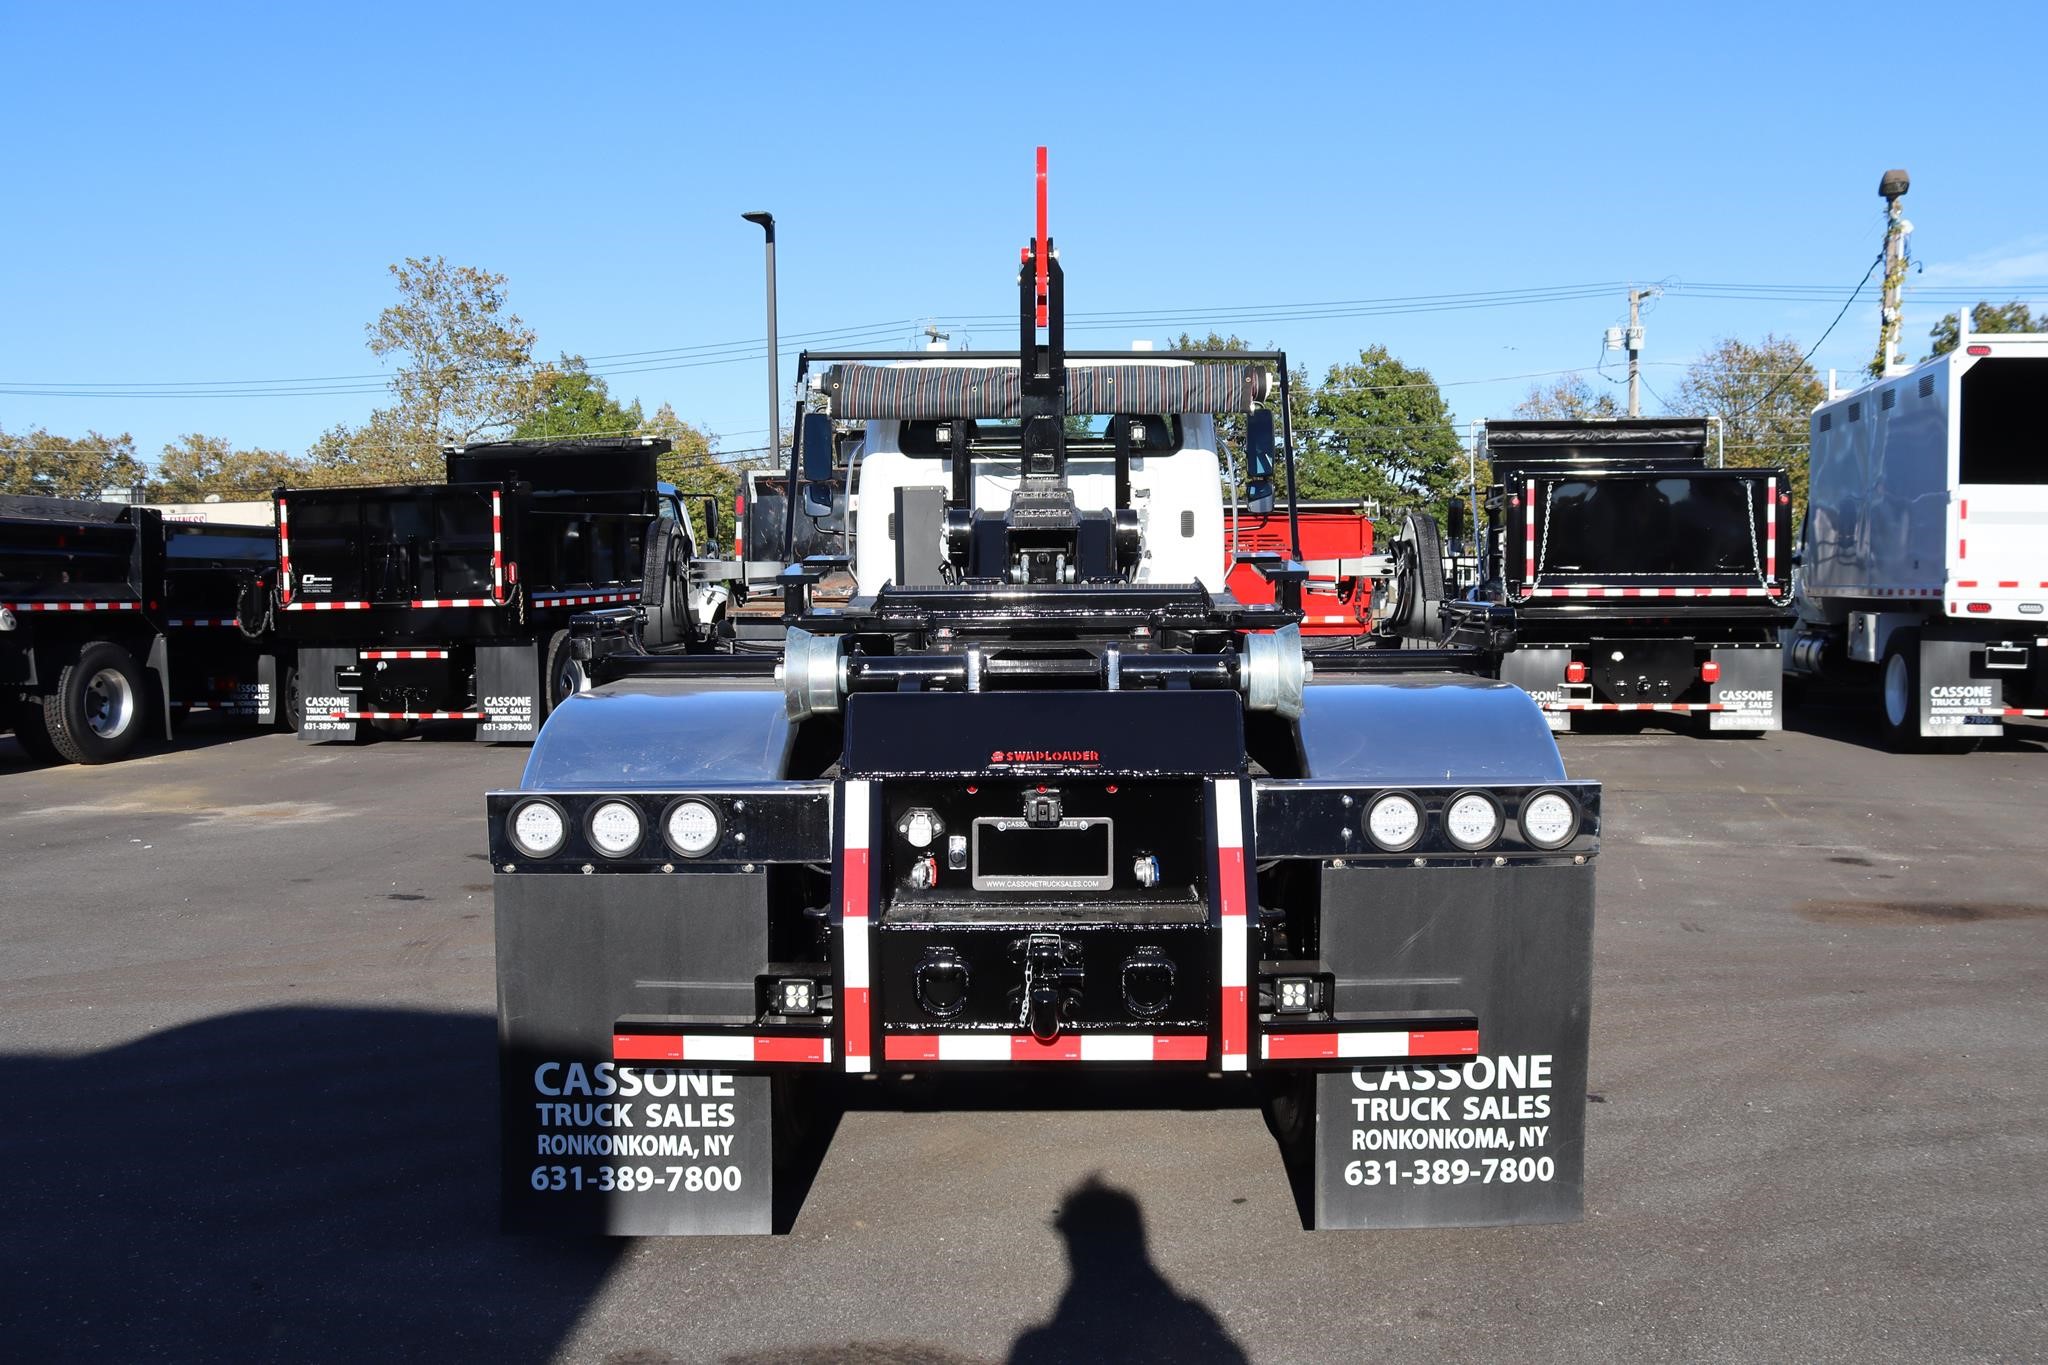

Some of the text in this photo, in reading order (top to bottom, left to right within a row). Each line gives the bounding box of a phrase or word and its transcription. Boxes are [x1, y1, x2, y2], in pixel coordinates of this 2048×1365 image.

[1719, 690, 1773, 701] CASSONE
[1930, 686, 1992, 697] CASSONE
[305, 697, 349, 707] CASSONE
[484, 696, 531, 707] CASSONE
[1748, 701, 1773, 709] SALES
[1931, 698, 1992, 706] TRUCK SALES
[304, 722, 350, 730] 631-389-7800
[482, 723, 532, 731] 631-389-7800
[1006, 751, 1100, 761] SWAPLOADER
[986, 880, 1099, 888] WWW.CASSONETRUCKSALES.COM
[1351, 1054, 1552, 1092] CASSONE
[534, 1062, 735, 1097] CASSONE
[1352, 1094, 1551, 1122] TRUCK SALES
[536, 1103, 736, 1128] TRUCK SALES
[1352, 1125, 1549, 1151] RONKONKOMA, NY
[537, 1134, 735, 1160] RONKONKOMA, NY
[1344, 1156, 1555, 1186] 631-389-7800
[531, 1165, 742, 1192] 631-389-7800
